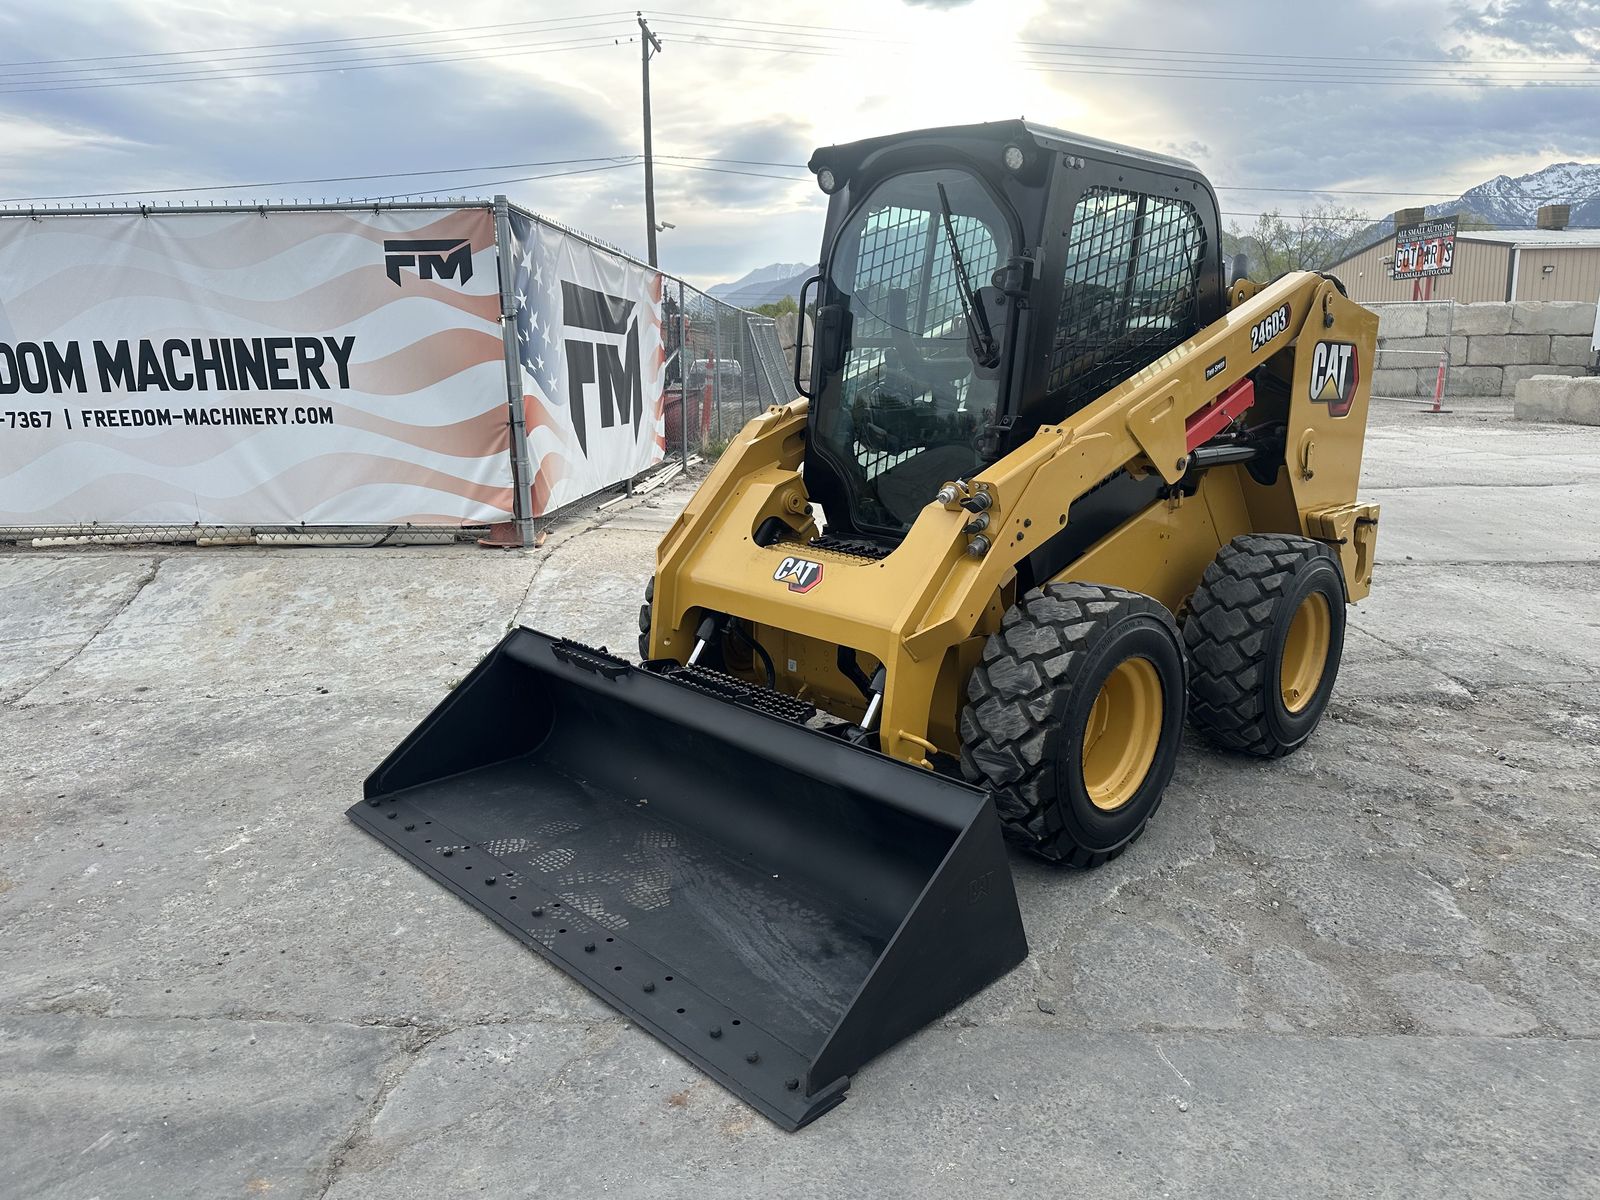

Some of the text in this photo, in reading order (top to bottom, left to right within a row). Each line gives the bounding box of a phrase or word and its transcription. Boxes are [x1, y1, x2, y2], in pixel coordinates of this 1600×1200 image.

[1398, 230, 1407, 238] ALL
[1408, 227, 1426, 236] SMALL
[1427, 224, 1442, 233] AUTO
[383, 238, 474, 288] FM
[1395, 267, 1451, 279] ALLSMALLAUTO.COM
[1251, 306, 1287, 353] 246D3
[92, 336, 356, 393] MACHINERY
[560, 279, 644, 461] FM
[1310, 341, 1352, 400] CAT
[81, 406, 335, 428] FREEDOM-MACHINERY.COM
[773, 557, 819, 586] CAT
